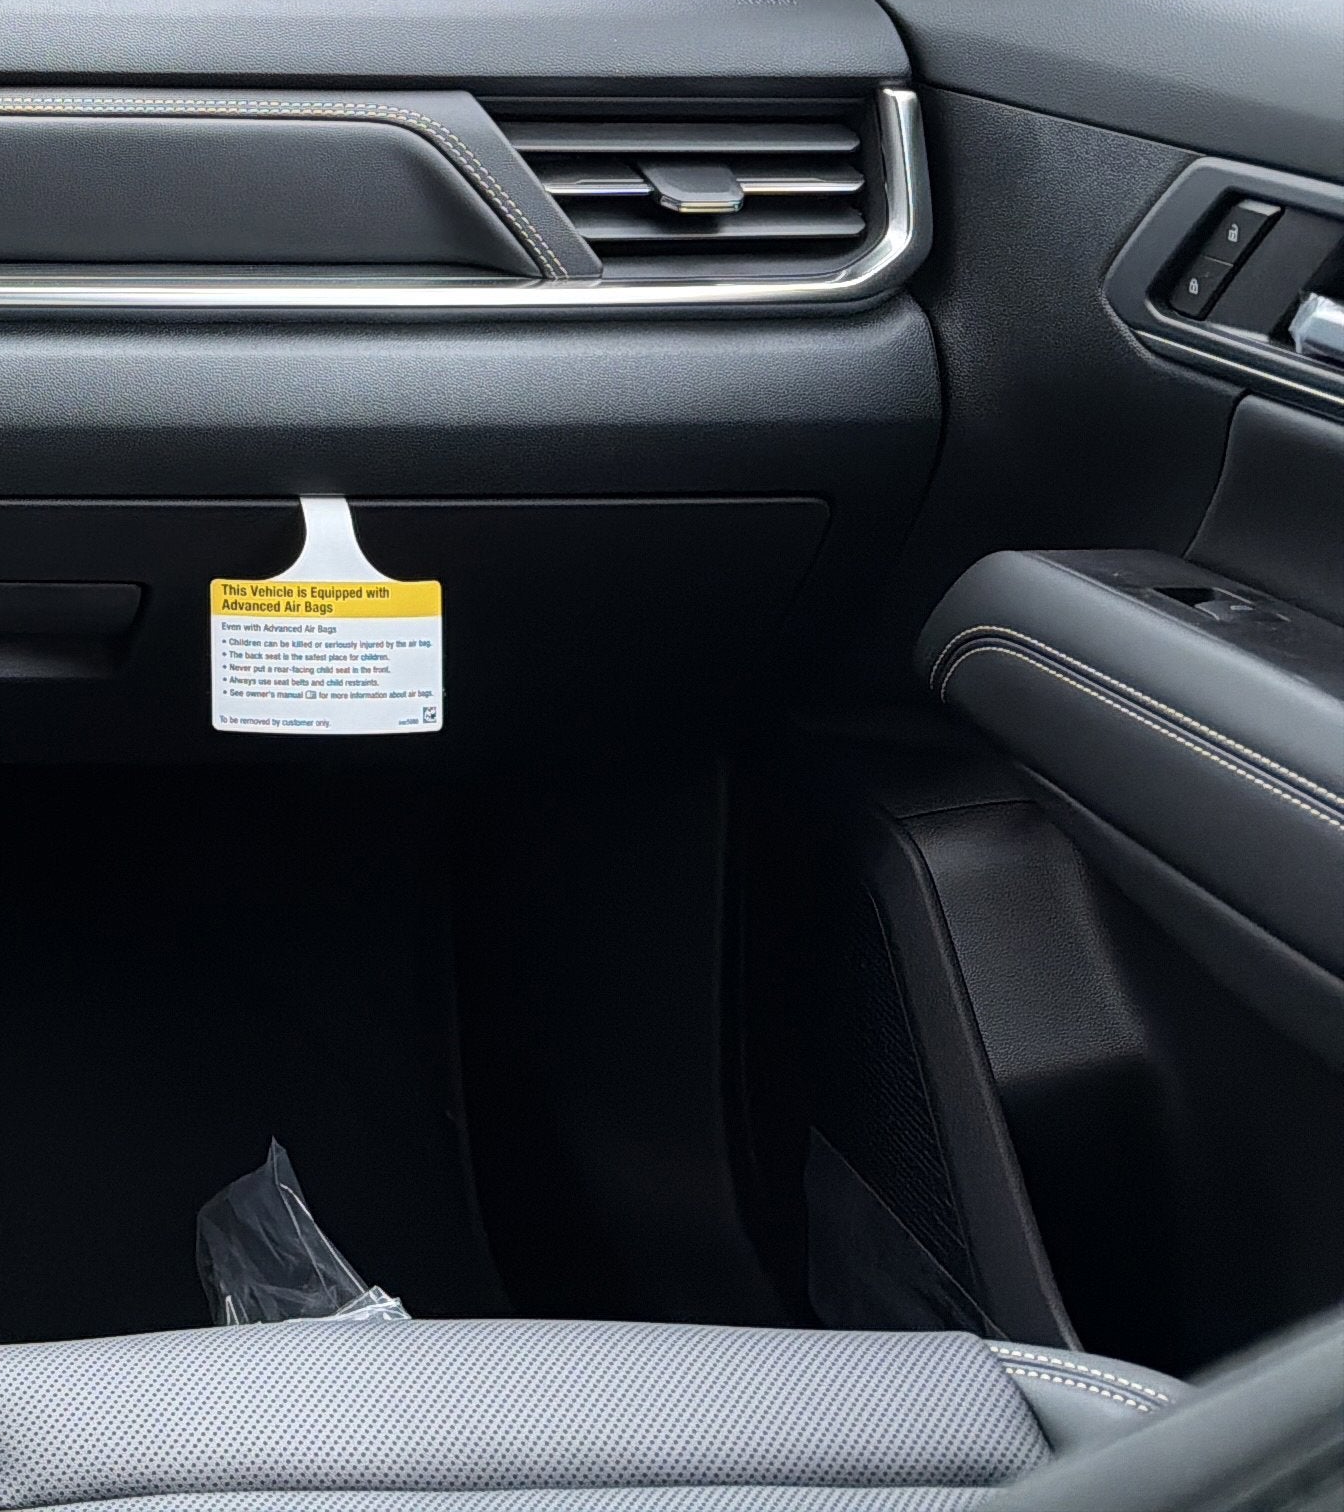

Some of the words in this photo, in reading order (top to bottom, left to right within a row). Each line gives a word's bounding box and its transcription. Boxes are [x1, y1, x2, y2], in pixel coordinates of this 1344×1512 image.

[222, 584, 247, 596] This
[250, 585, 294, 597] Vehicle
[297, 586, 307, 598] is
[311, 586, 363, 601] Equipped
[366, 586, 390, 598] with
[222, 599, 280, 612] Advanced
[284, 600, 301, 612] Air
[305, 601, 333, 615] Bags
[221, 622, 241, 630] Even
[244, 623, 261, 631] with
[263, 624, 302, 633] Advanced
[305, 625, 315, 633] Air
[318, 625, 337, 634] Bags
[229, 638, 261, 647] Children
[280, 640, 289, 648] be
[292, 640, 312, 648] killed
[324, 640, 357, 649] seriously
[360, 640, 384, 650] injured
[386, 640, 394, 649] by
[396, 640, 406, 648] the
[229, 651, 243, 659] The
[245, 652, 263, 660] back
[265, 653, 281, 661] seat
[291, 653, 303, 661] the
[329, 654, 347, 662] place
[361, 653, 390, 661] children.
[229, 663, 251, 671] Never
[253, 665, 265, 673] put
[274, 665, 314, 675] rear-facing
[316, 666, 333, 674] child
[360, 666, 371, 674] the
[229, 676, 256, 686] Always
[274, 678, 289, 686] seat
[291, 678, 309, 686] belts
[230, 689, 243, 697] See
[246, 690, 275, 698] owner's
[277, 691, 303, 699] manual
[319, 691, 328, 699] for
[350, 691, 387, 699] information
[219, 715, 227, 724] To
[230, 716, 238, 724] be
[240, 717, 270, 725] removed
[272, 718, 280, 727] by
[282, 719, 314, 727] customer
